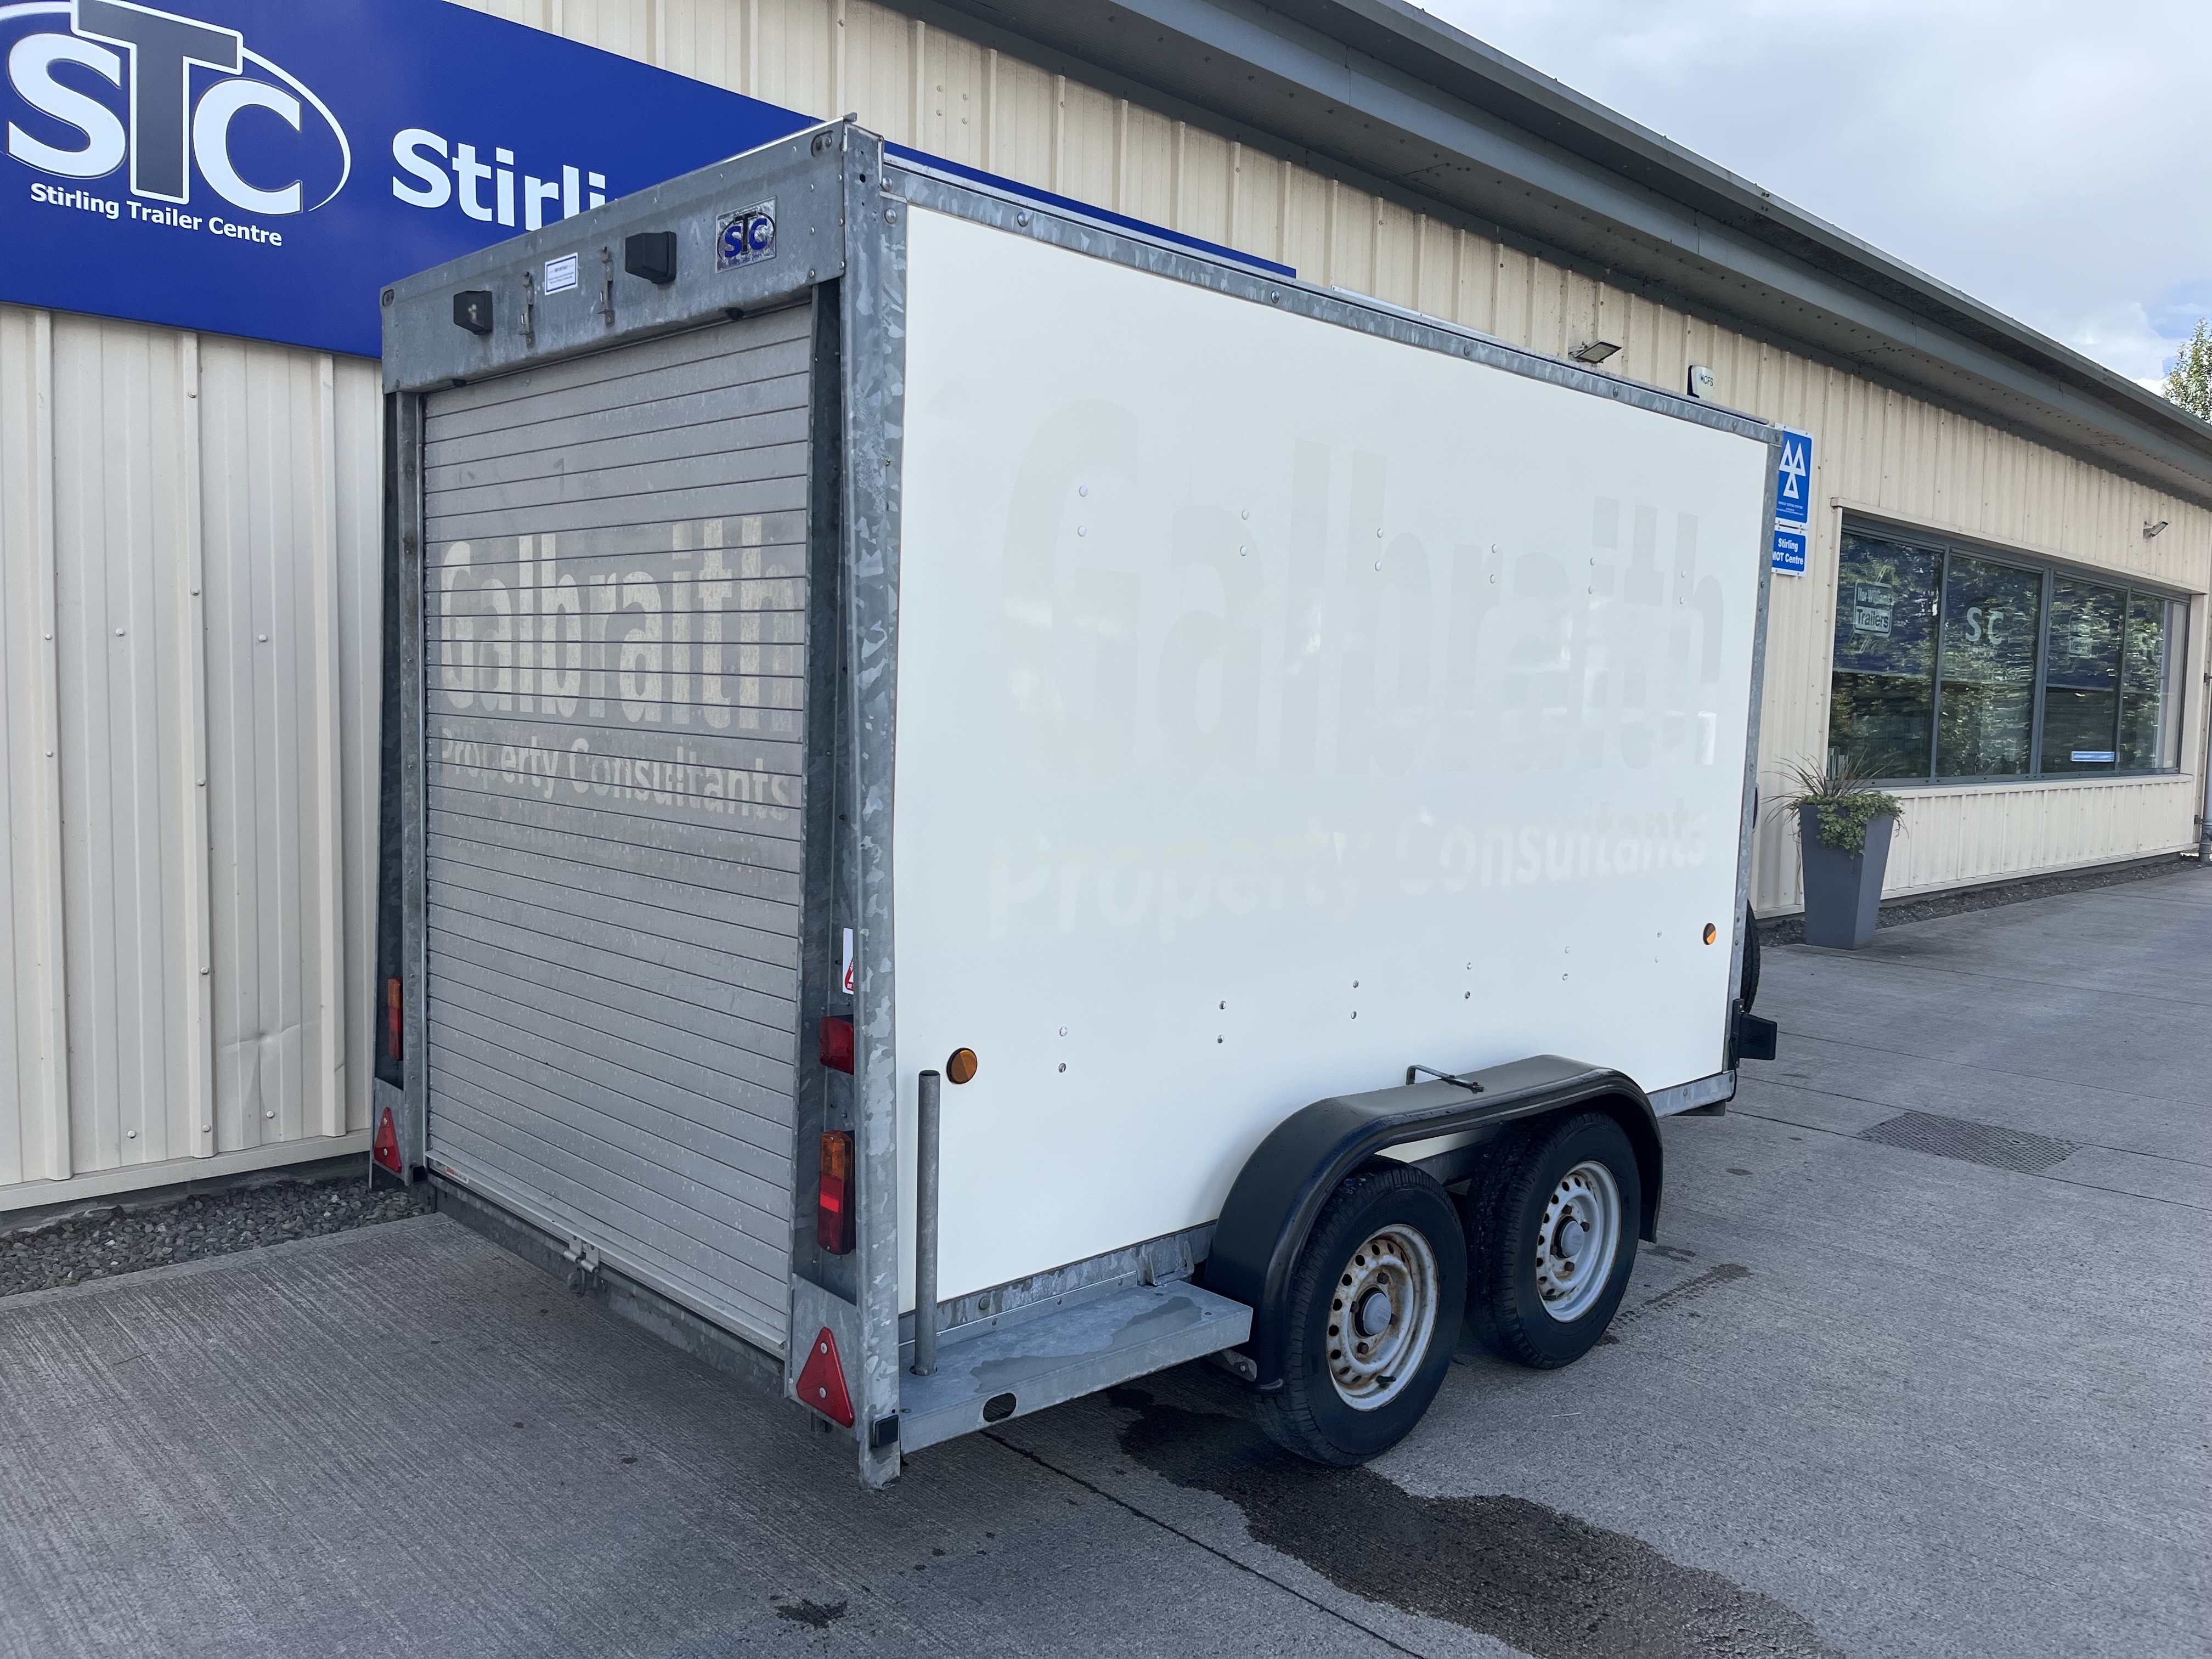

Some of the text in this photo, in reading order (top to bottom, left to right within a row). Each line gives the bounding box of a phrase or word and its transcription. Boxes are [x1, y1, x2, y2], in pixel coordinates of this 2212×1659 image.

[7, 0, 303, 215] STC
[31, 183, 283, 246] Stirling Trailer Centre
[724, 208, 768, 258] STC
[1778, 538, 1798, 552] Stirling
[1785, 553, 1804, 565] Centre
[1001, 399, 1724, 779] Galbraith
[1857, 609, 1889, 628] Trailers
[441, 516, 794, 732] Galbraith
[442, 727, 789, 821] Property Consultants
